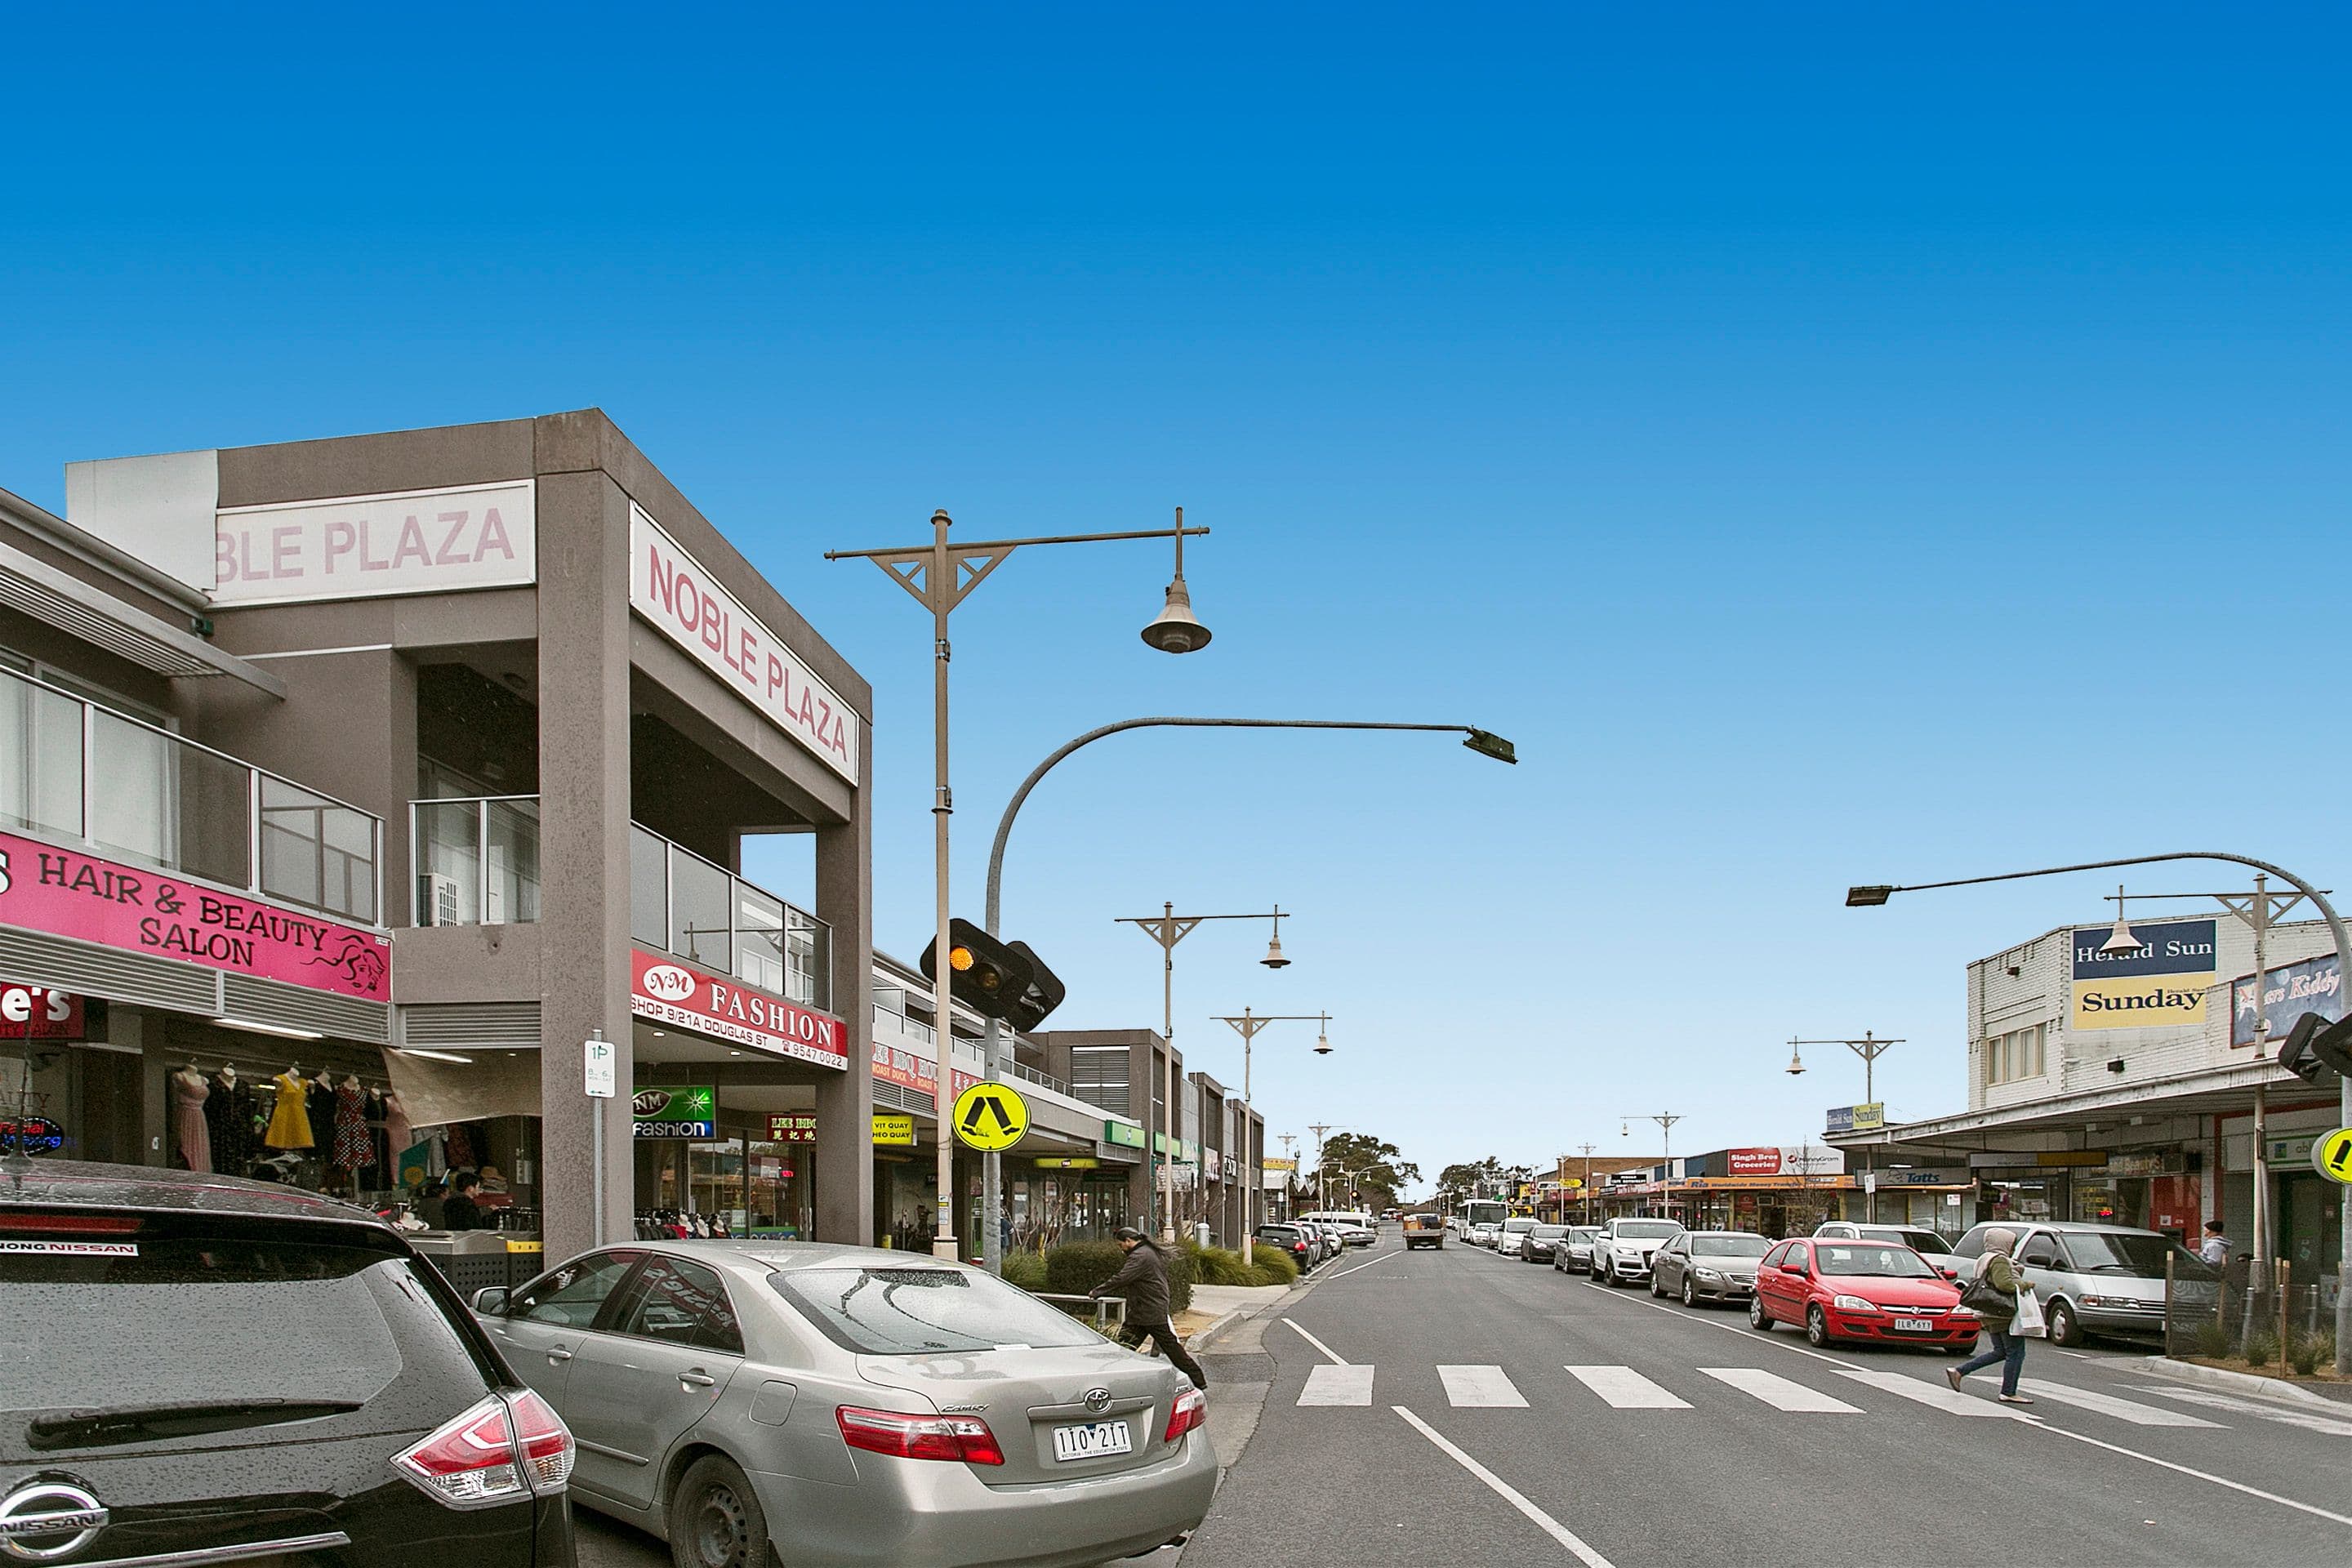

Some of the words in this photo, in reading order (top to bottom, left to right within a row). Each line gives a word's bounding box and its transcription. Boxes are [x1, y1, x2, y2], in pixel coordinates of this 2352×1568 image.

[325, 507, 515, 574] PLAZA
[649, 545, 757, 687] NOBLE
[768, 652, 848, 763] PLAZA
[38, 853, 143, 906] HAIR
[154, 884, 186, 915] &
[199, 897, 328, 951] BEAUTY
[140, 917, 255, 966] SALON
[2166, 940, 2213, 957] Sun
[2288, 969, 2340, 999] Kiddy
[0, 985, 72, 1022] e's
[650, 971, 688, 993] NM
[710, 982, 832, 1047] FASHION
[2082, 989, 2205, 1012] Sunday
[631, 997, 663, 1016] SHOP
[668, 1008, 700, 1028] 9/21A
[705, 1021, 752, 1044] DOUGLAS
[756, 1036, 768, 1047] ST
[793, 1046, 816, 1059] 9547
[820, 1052, 842, 1067] 0022
[633, 1094, 662, 1110] NM
[772, 1118, 793, 1129] LEE
[1829, 1115, 1842, 1125] Herald
[1842, 1112, 1852, 1124] Sun
[1855, 1107, 1880, 1124] Sunday
[1907, 1173, 1940, 1183] Tatts
[50, 1244, 134, 1253] NISSAN
[0, 1514, 96, 1532] NISSAN
